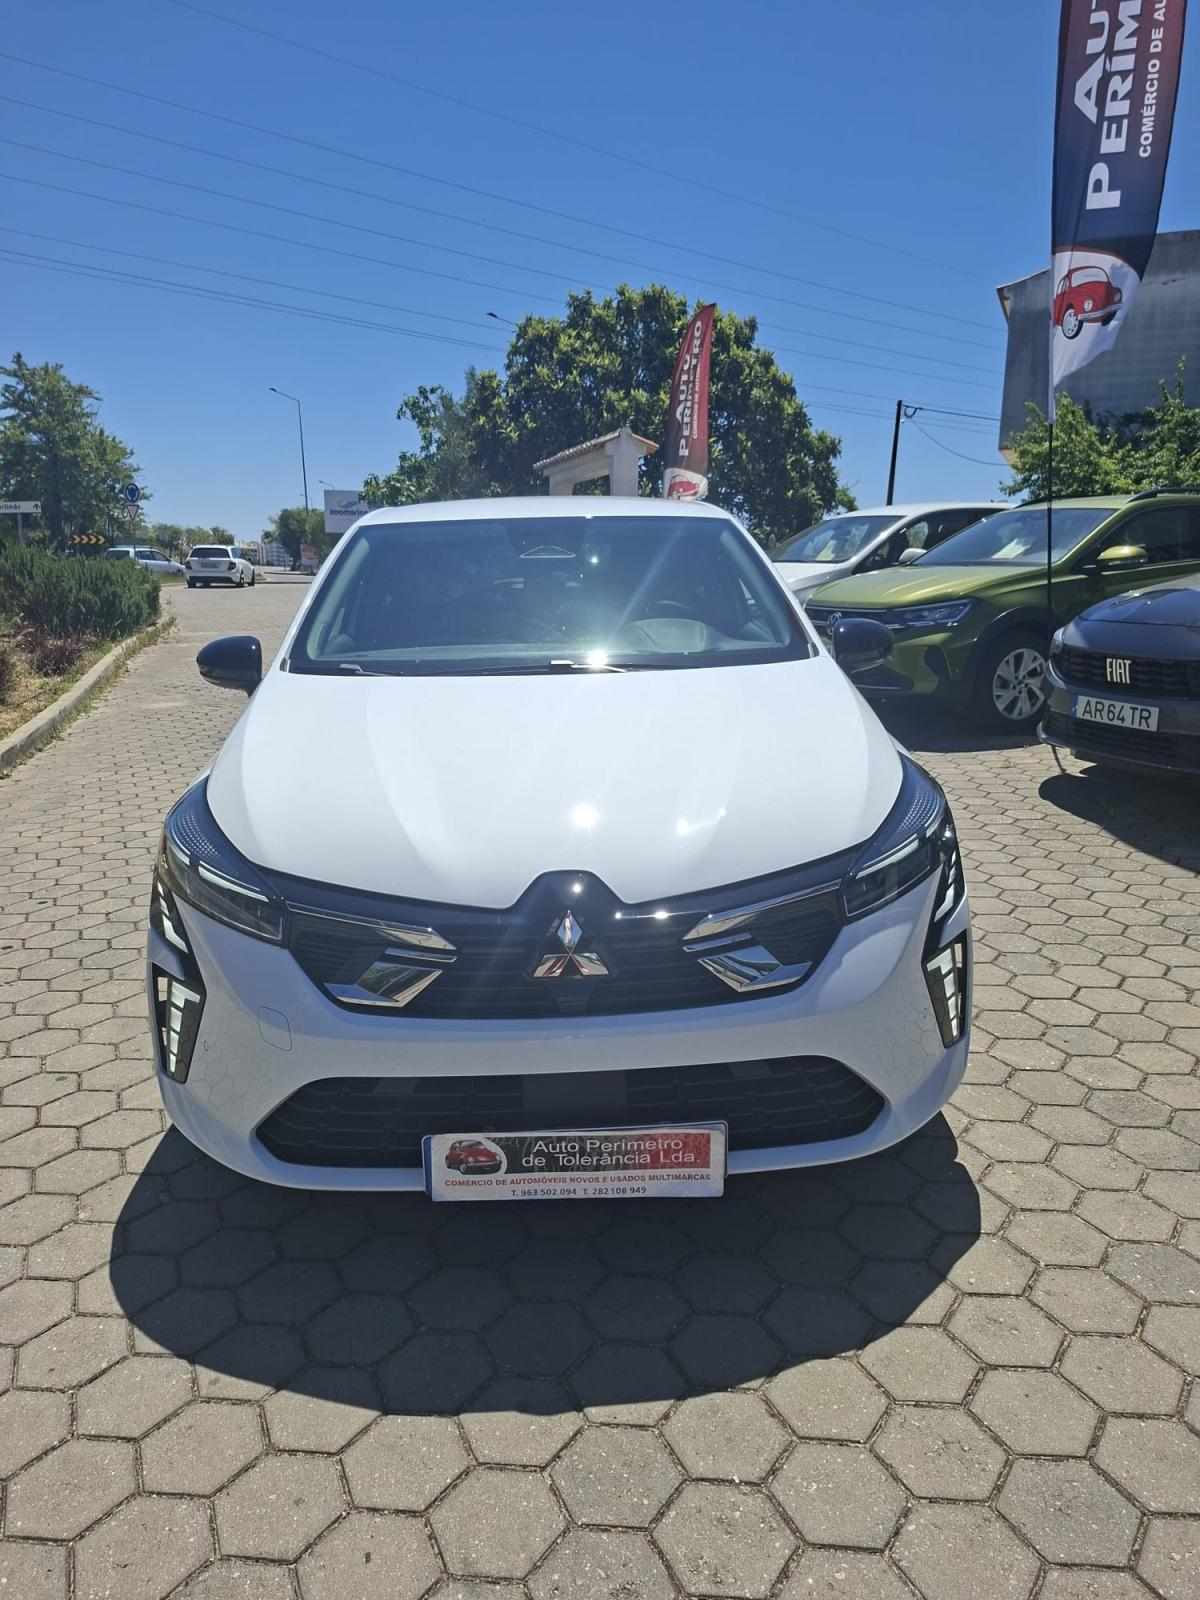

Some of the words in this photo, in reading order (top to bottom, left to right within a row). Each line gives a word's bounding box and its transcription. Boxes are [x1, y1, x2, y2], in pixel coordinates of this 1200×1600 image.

[1074, 0, 1110, 125] AU
[1138, 59, 1160, 158] COMÉRCIO
[1150, 27, 1164, 53] DE
[1106, 658, 1132, 684] FIAT
[532, 1139, 579, 1153] Auto
[521, 1154, 546, 1167] de
[554, 1151, 651, 1167] Tolerância
[660, 1149, 700, 1163] Lda.
[569, 1176, 600, 1184] NOVOS
[609, 1174, 646, 1183] USADOS
[648, 1172, 711, 1182] MULTIMARCAS
[629, 1185, 648, 1194] 949
